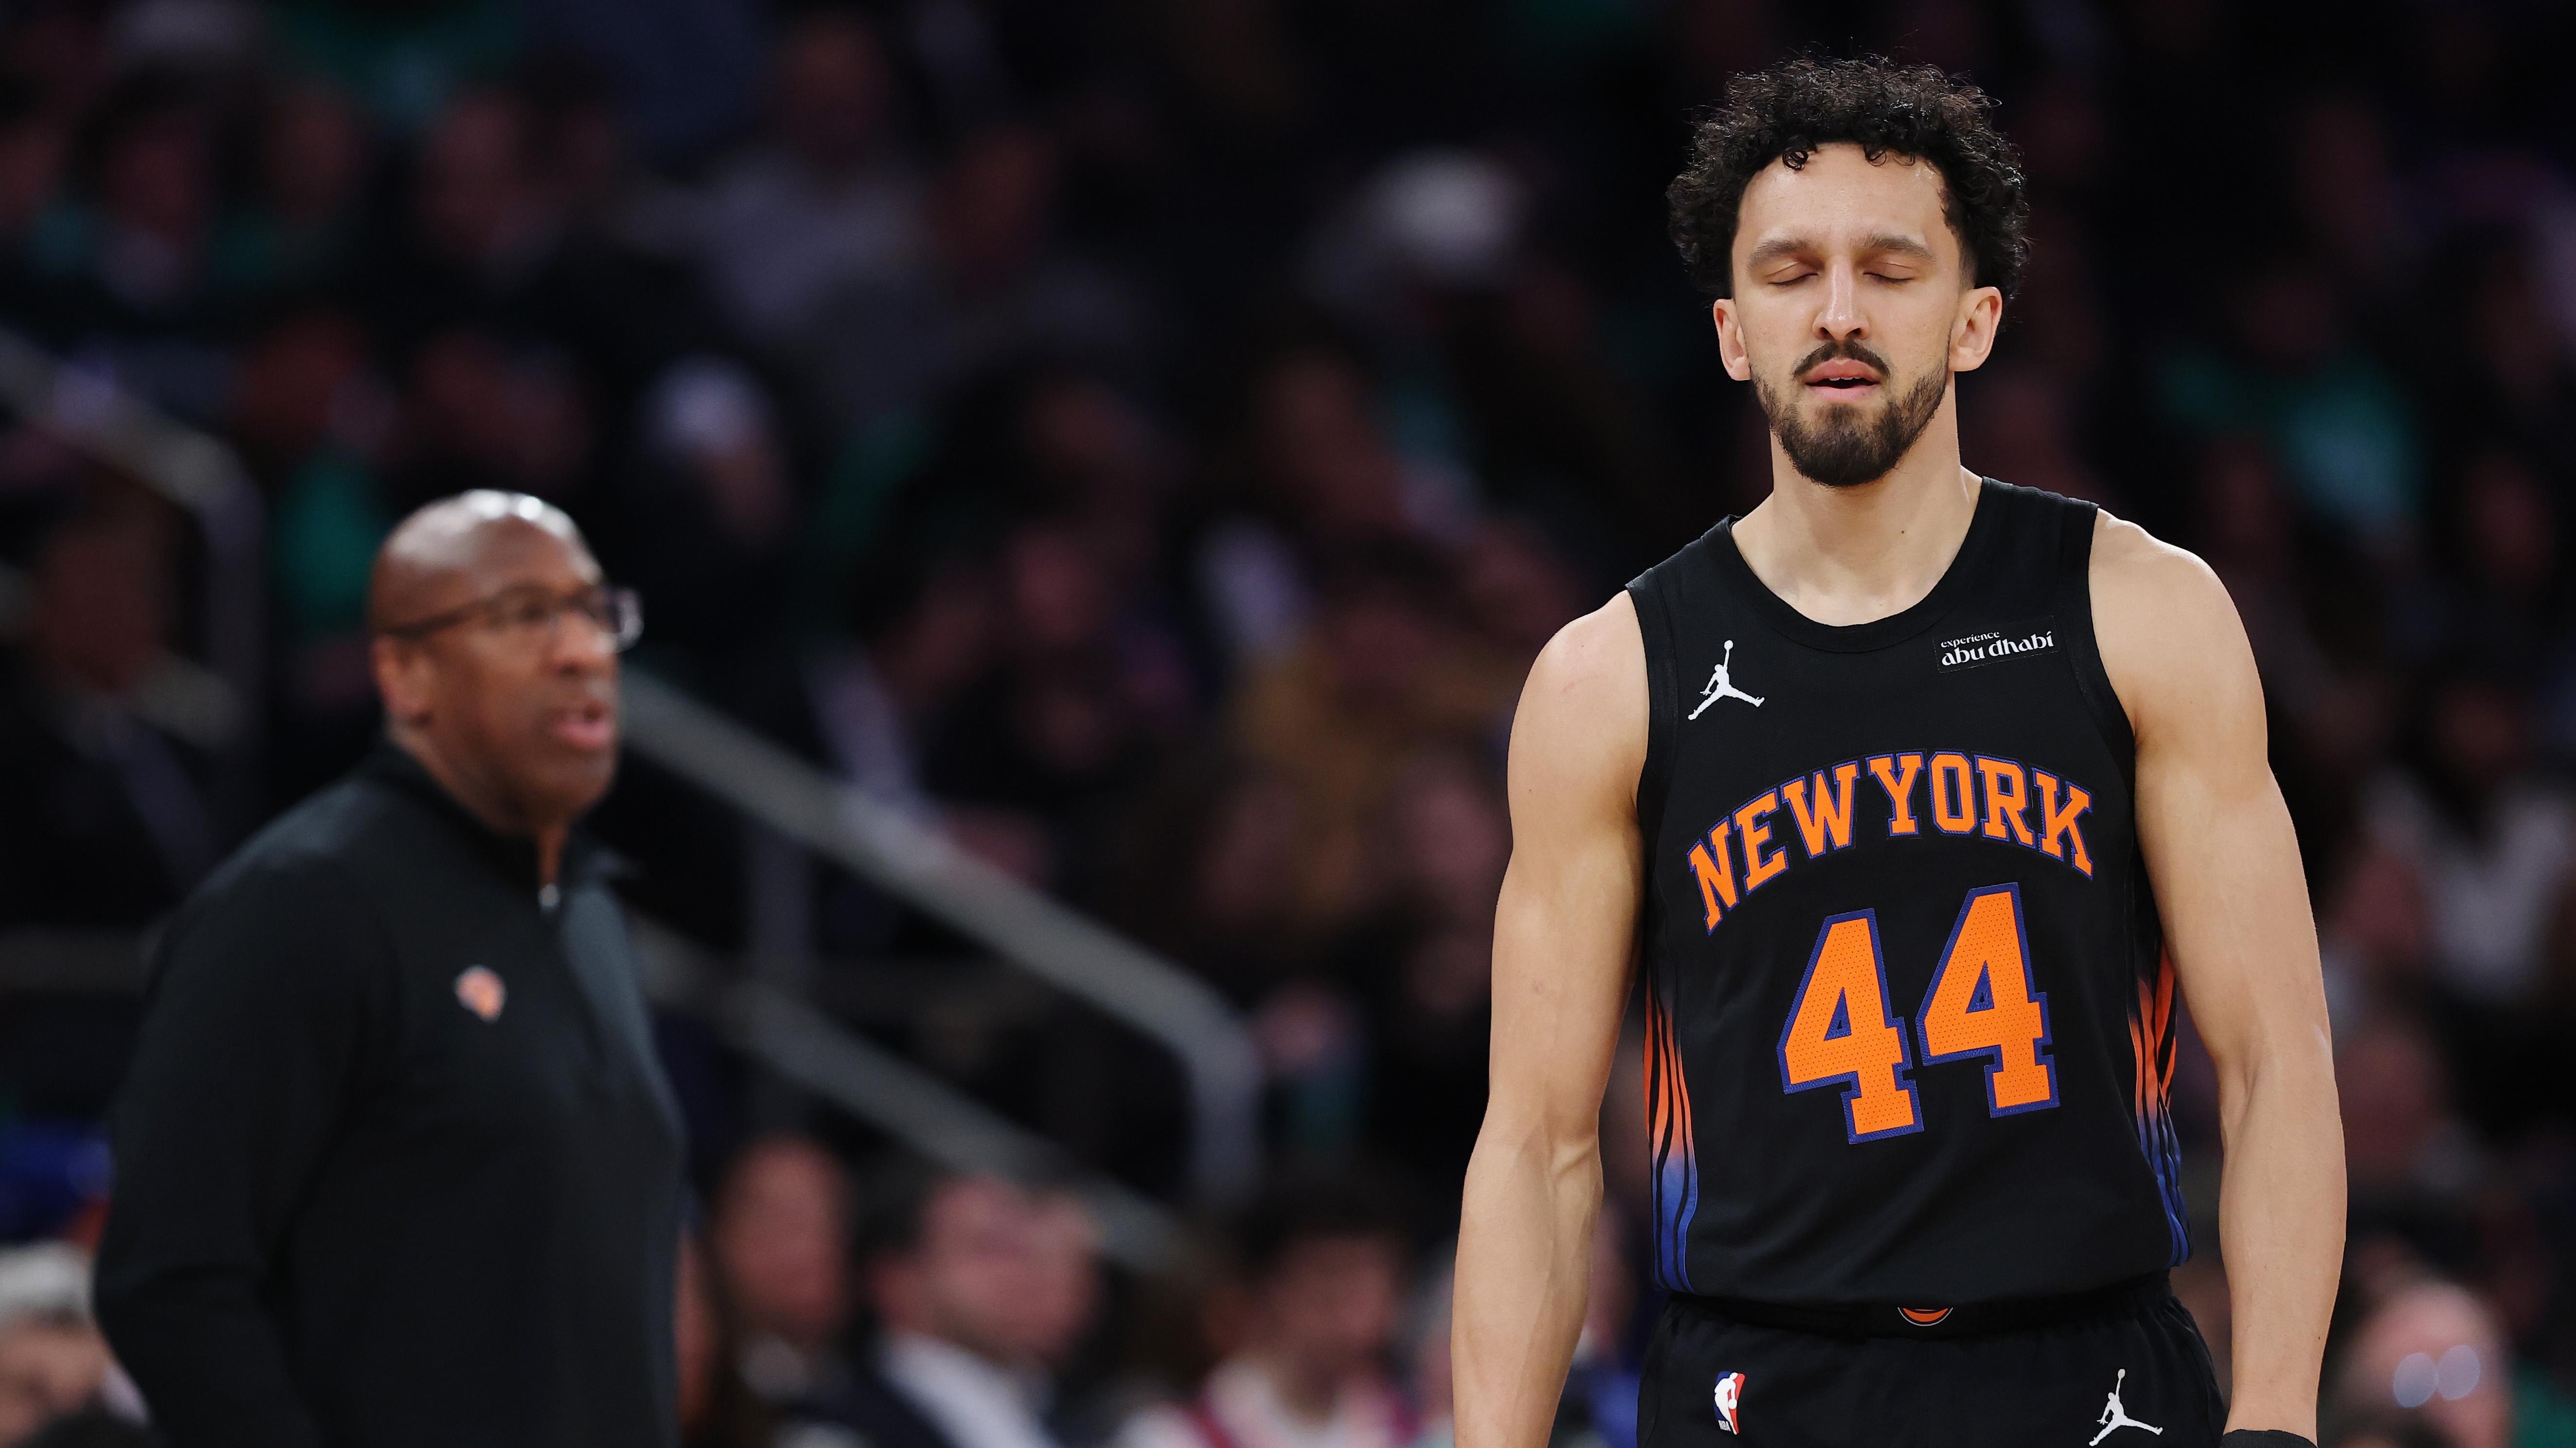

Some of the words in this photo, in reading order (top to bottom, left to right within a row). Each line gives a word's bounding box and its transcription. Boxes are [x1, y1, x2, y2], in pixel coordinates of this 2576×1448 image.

[1941, 631, 2000, 648] experience
[1941, 646, 1985, 666] abu
[1686, 761, 1858, 935] NEW
[1866, 751, 2093, 881] YORK
[1776, 882, 2060, 1144] 44
[1718, 1420, 1731, 1432] NBA
